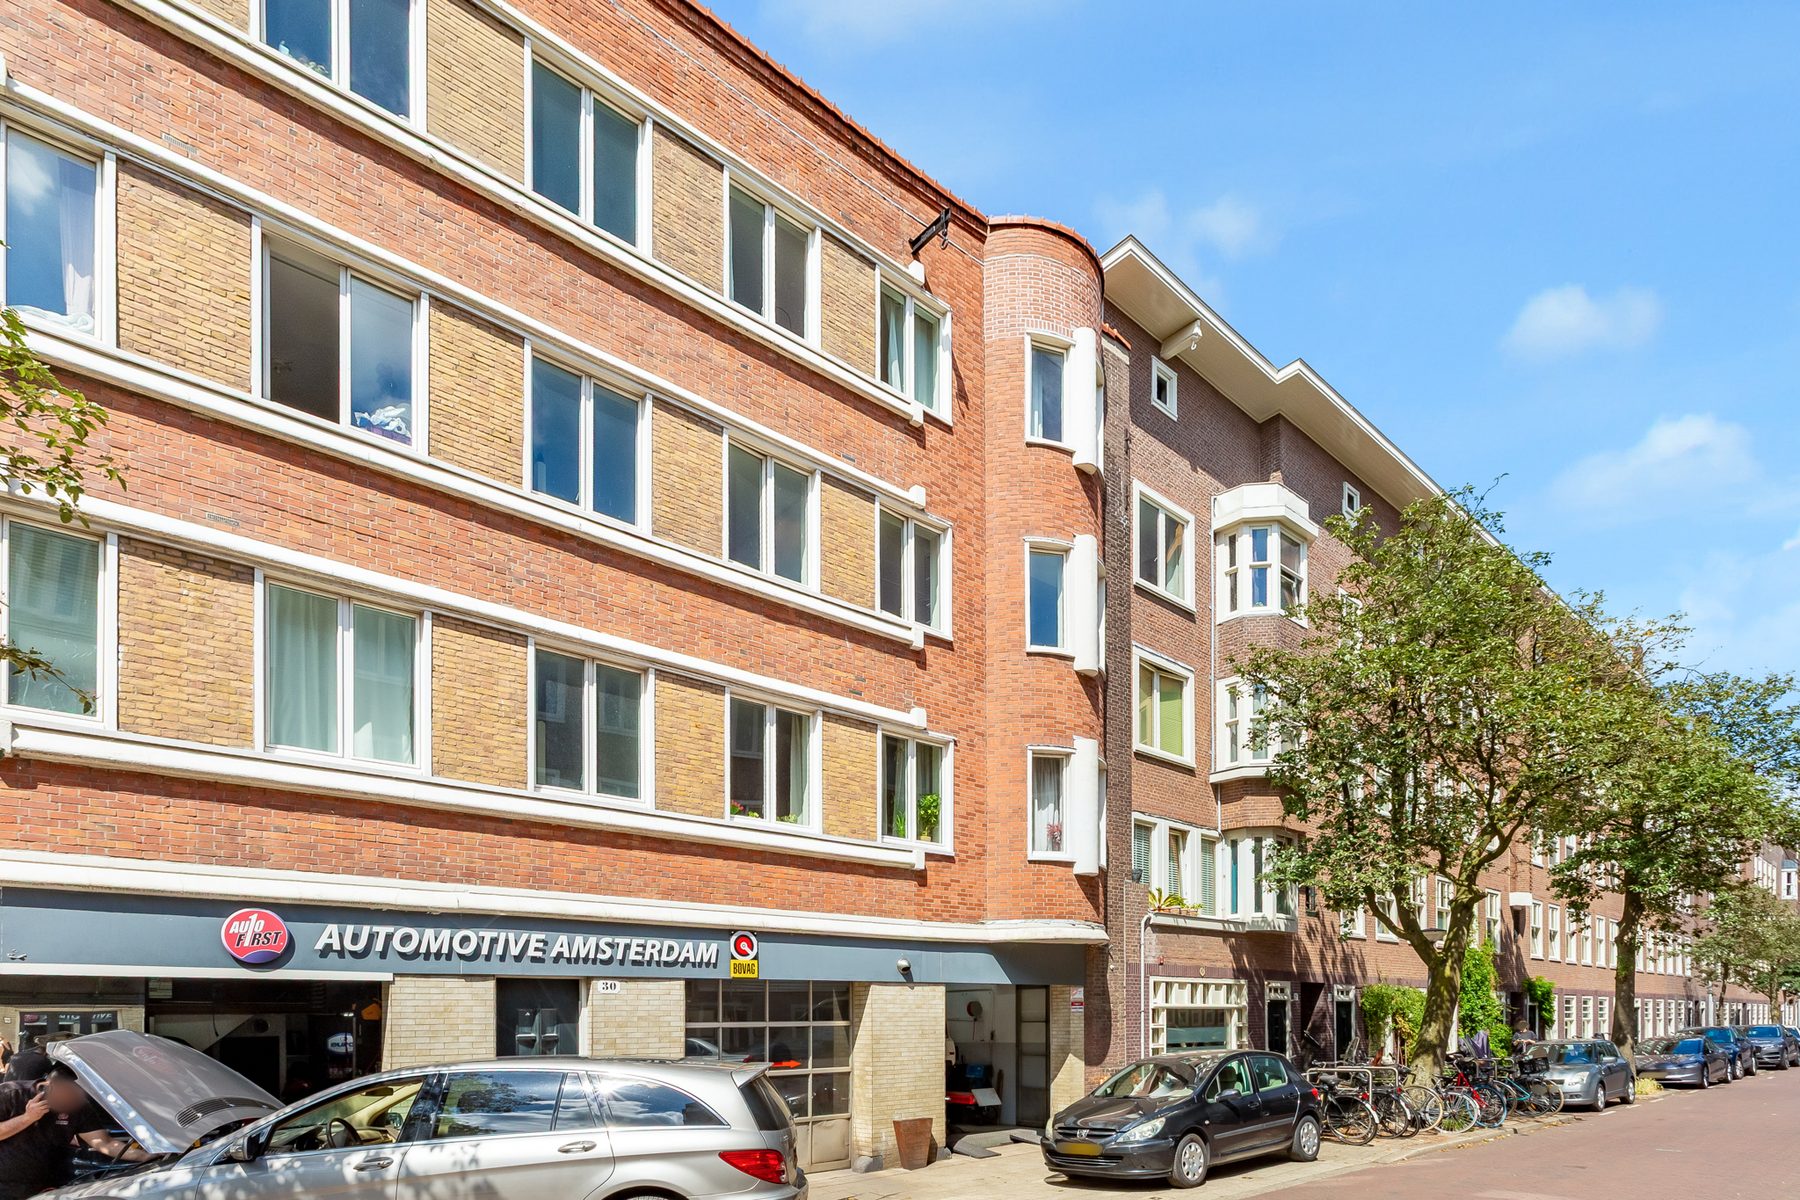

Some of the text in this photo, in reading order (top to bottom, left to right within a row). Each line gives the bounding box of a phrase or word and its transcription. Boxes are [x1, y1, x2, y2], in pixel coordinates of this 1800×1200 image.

[314, 924, 718, 964] AUTOMOTIVE AMSTERDAM
[733, 963, 756, 975] BOVAG
[602, 981, 617, 991] 30
